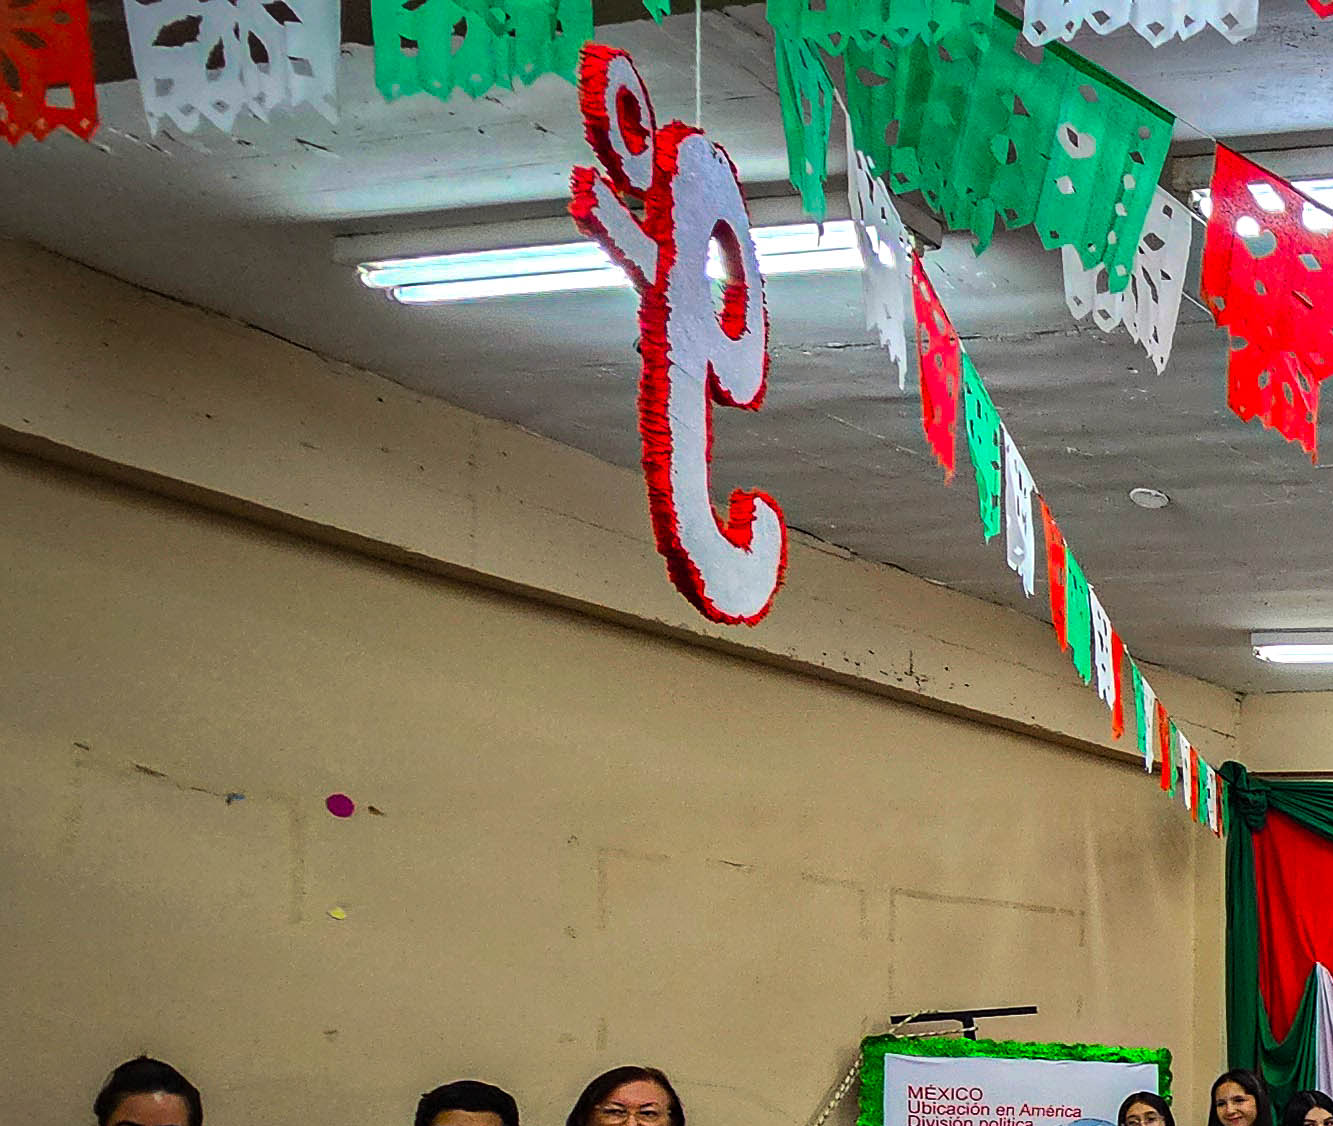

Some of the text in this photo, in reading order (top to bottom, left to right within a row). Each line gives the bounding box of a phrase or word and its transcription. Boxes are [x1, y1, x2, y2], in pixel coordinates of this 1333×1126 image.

[907, 1084, 983, 1101] MÉXICO
[907, 1100, 1082, 1118] Ubicación en América
